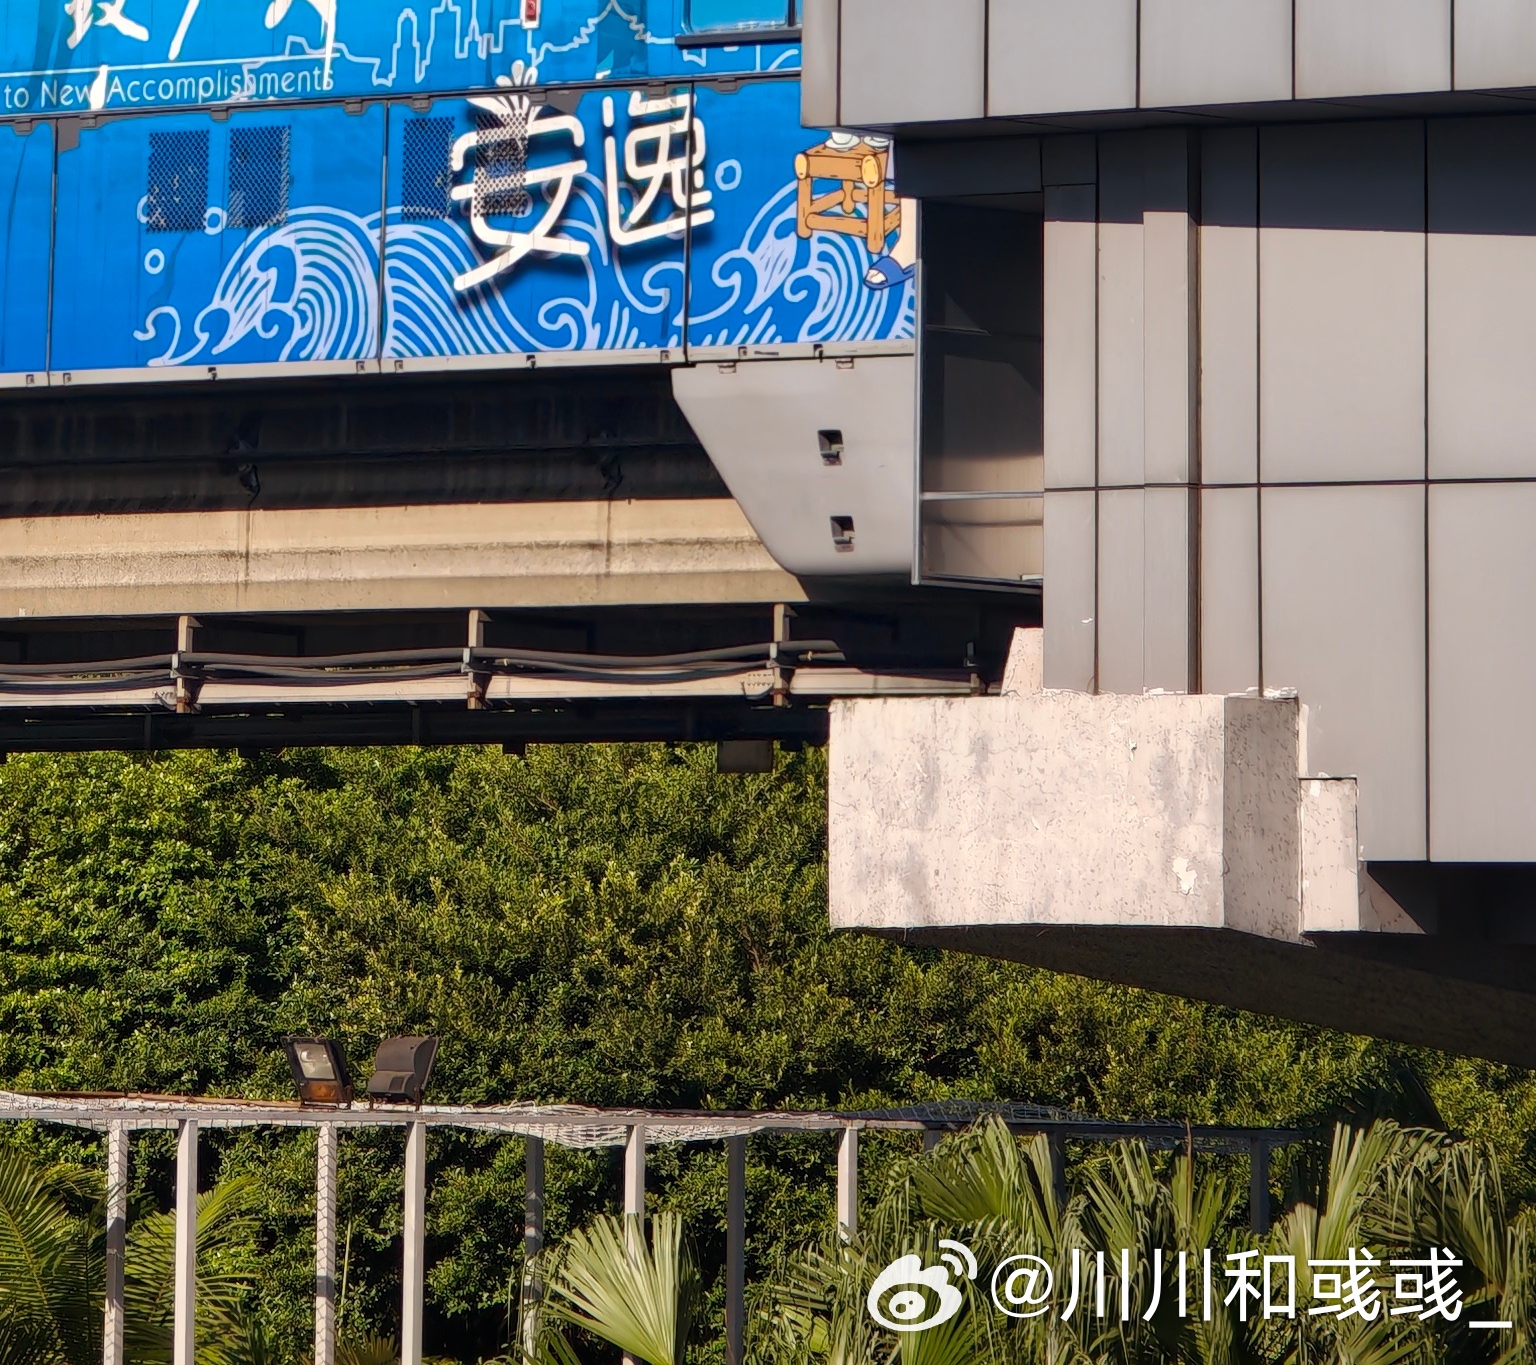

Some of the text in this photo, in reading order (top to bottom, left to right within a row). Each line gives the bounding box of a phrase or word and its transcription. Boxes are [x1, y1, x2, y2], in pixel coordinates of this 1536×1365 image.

[4, 84, 29, 108] to
[41, 79, 92, 108] New
[106, 65, 334, 103] Accomplishments
[450, 62, 715, 291] 安逸
